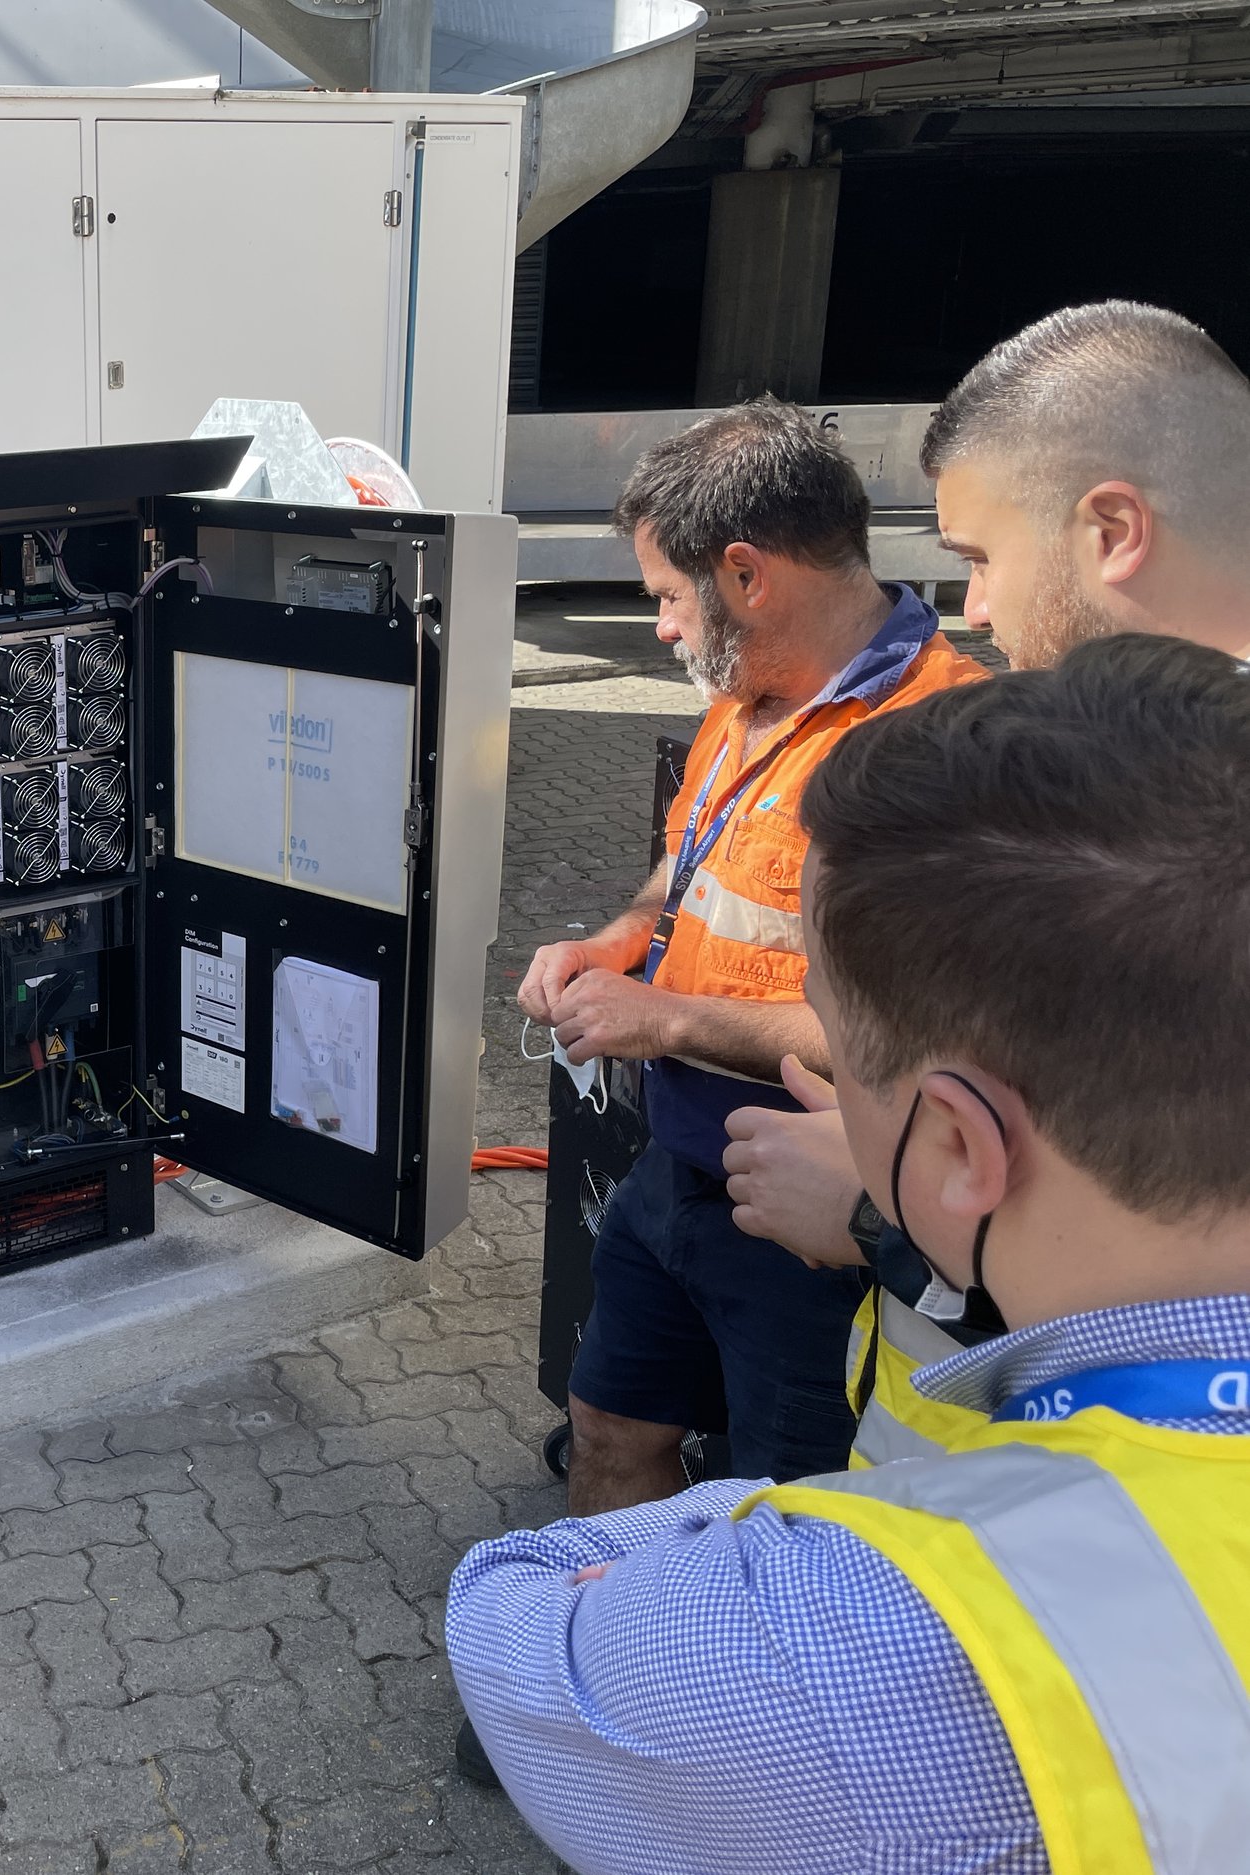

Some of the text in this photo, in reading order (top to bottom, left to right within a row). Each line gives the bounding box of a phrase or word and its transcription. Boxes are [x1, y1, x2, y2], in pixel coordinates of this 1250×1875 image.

[267, 757, 275, 771] P
[688, 805, 701, 829] SYD
[721, 798, 736, 821] SYD
[300, 839, 307, 853] 4
[702, 829, 715, 849] Airport
[296, 856, 319, 874] 779
[676, 871, 692, 891] SYD
[184, 935, 219, 950] Configuration
